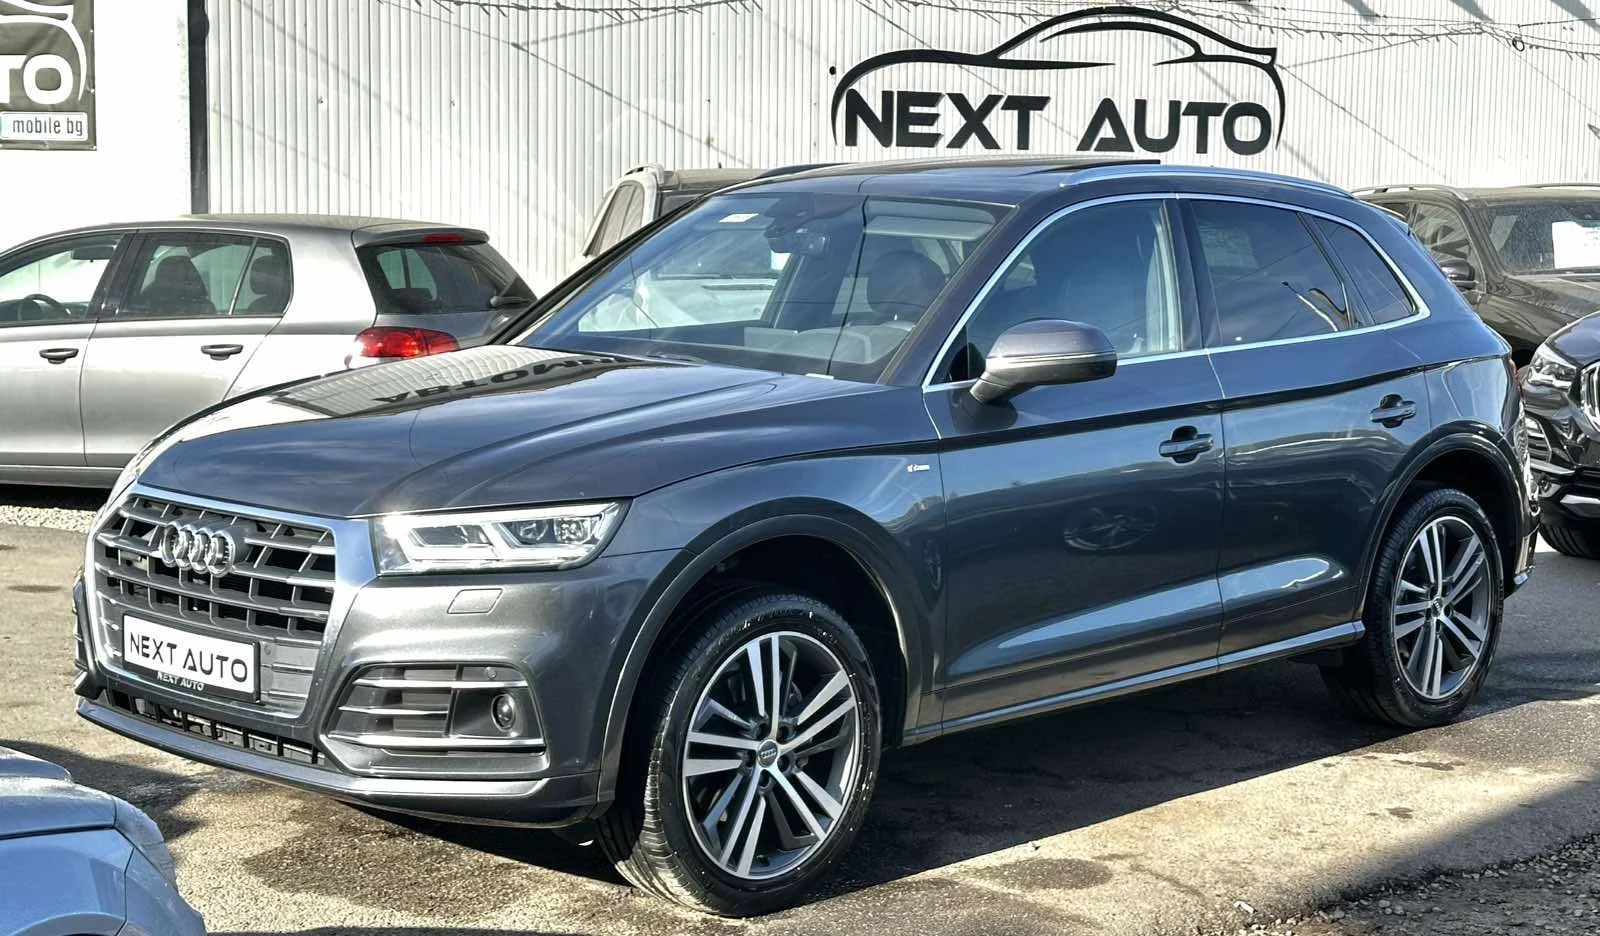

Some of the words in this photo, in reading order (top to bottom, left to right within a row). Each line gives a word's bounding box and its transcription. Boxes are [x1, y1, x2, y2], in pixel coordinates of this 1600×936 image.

[12, 116, 61, 134] mobile
[66, 117, 83, 137] bg
[845, 89, 1050, 150] NEXT
[1077, 98, 1271, 155] AUTO
[130, 632, 177, 665] NEXT
[182, 648, 248, 683] AUTO
[156, 671, 179, 685] NEXT
[180, 678, 205, 691] AUTO
